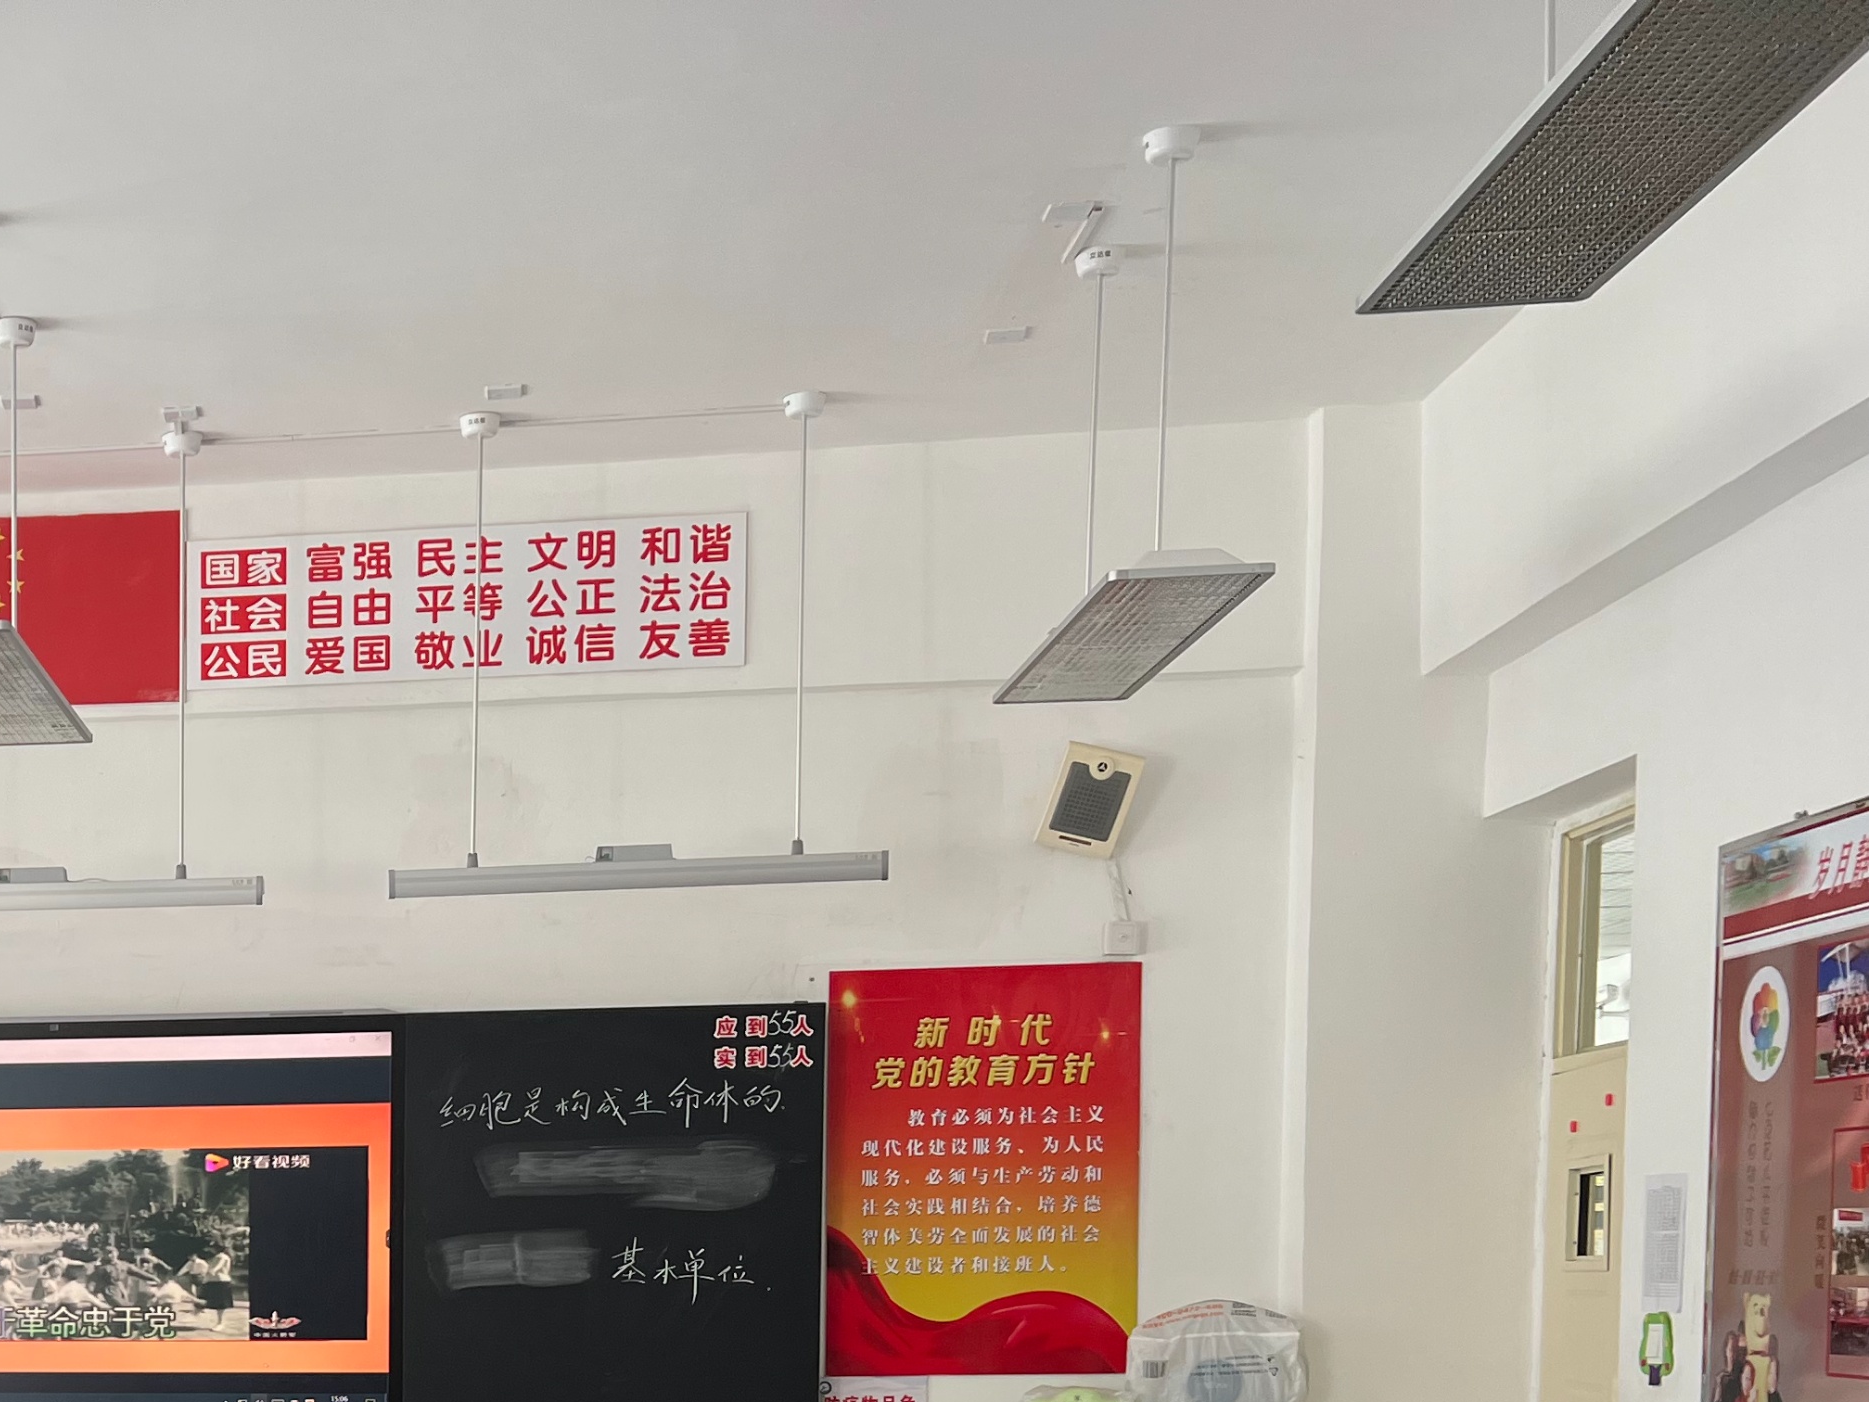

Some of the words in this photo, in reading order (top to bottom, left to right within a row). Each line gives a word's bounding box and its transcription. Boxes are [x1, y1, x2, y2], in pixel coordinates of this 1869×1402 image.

[204, 550, 284, 587] 国家
[305, 540, 394, 583] 富强
[415, 535, 504, 577] 民主
[526, 530, 617, 572] 文明
[640, 523, 733, 567] 和谐
[204, 597, 283, 632] 社会
[305, 587, 392, 629] 自由
[414, 582, 504, 624] 平等
[526, 578, 618, 618] 公正
[638, 570, 733, 614] 法治
[203, 643, 282, 679] 公民
[304, 635, 391, 676] 爱国
[414, 628, 504, 671] 敬业
[525, 623, 617, 665] 诚信
[638, 617, 732, 661] 友善
[912, 1013, 1055, 1049] 新时代
[870, 1051, 1098, 1091] 党的教育方针
[907, 1104, 1106, 1128] 教育必须为社会主义
[232, 1152, 312, 1172] 好看视频
[861, 1224, 1102, 1247] 智体美劳全面发展的社会
[330, 1395, 349, 1402] 15:06
